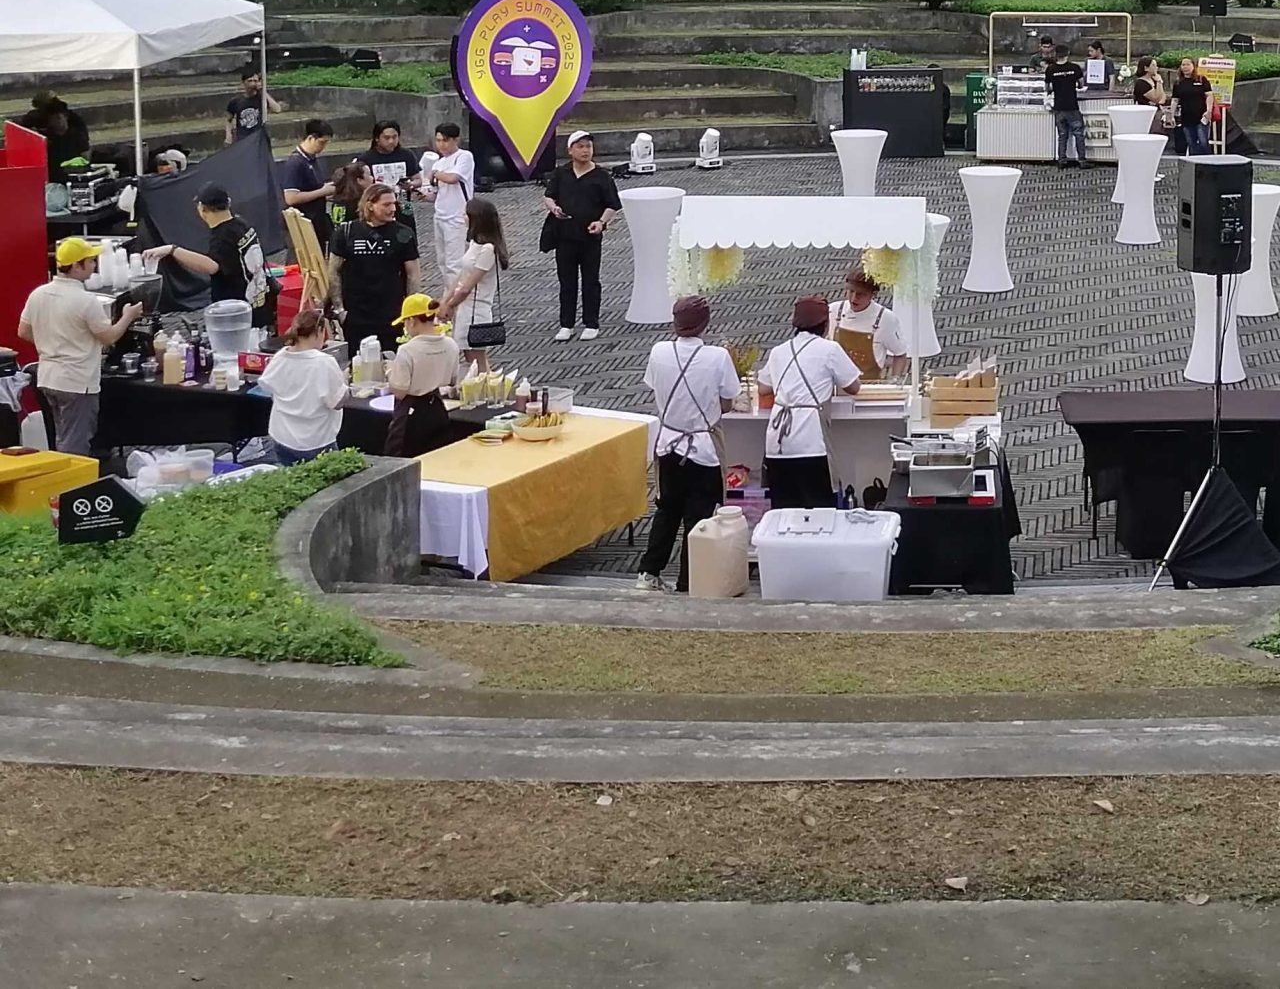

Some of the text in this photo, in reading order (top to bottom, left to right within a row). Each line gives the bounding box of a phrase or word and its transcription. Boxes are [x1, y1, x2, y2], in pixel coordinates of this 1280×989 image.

[474, 0, 575, 80] YGG PLAY SUMMIT 2025
